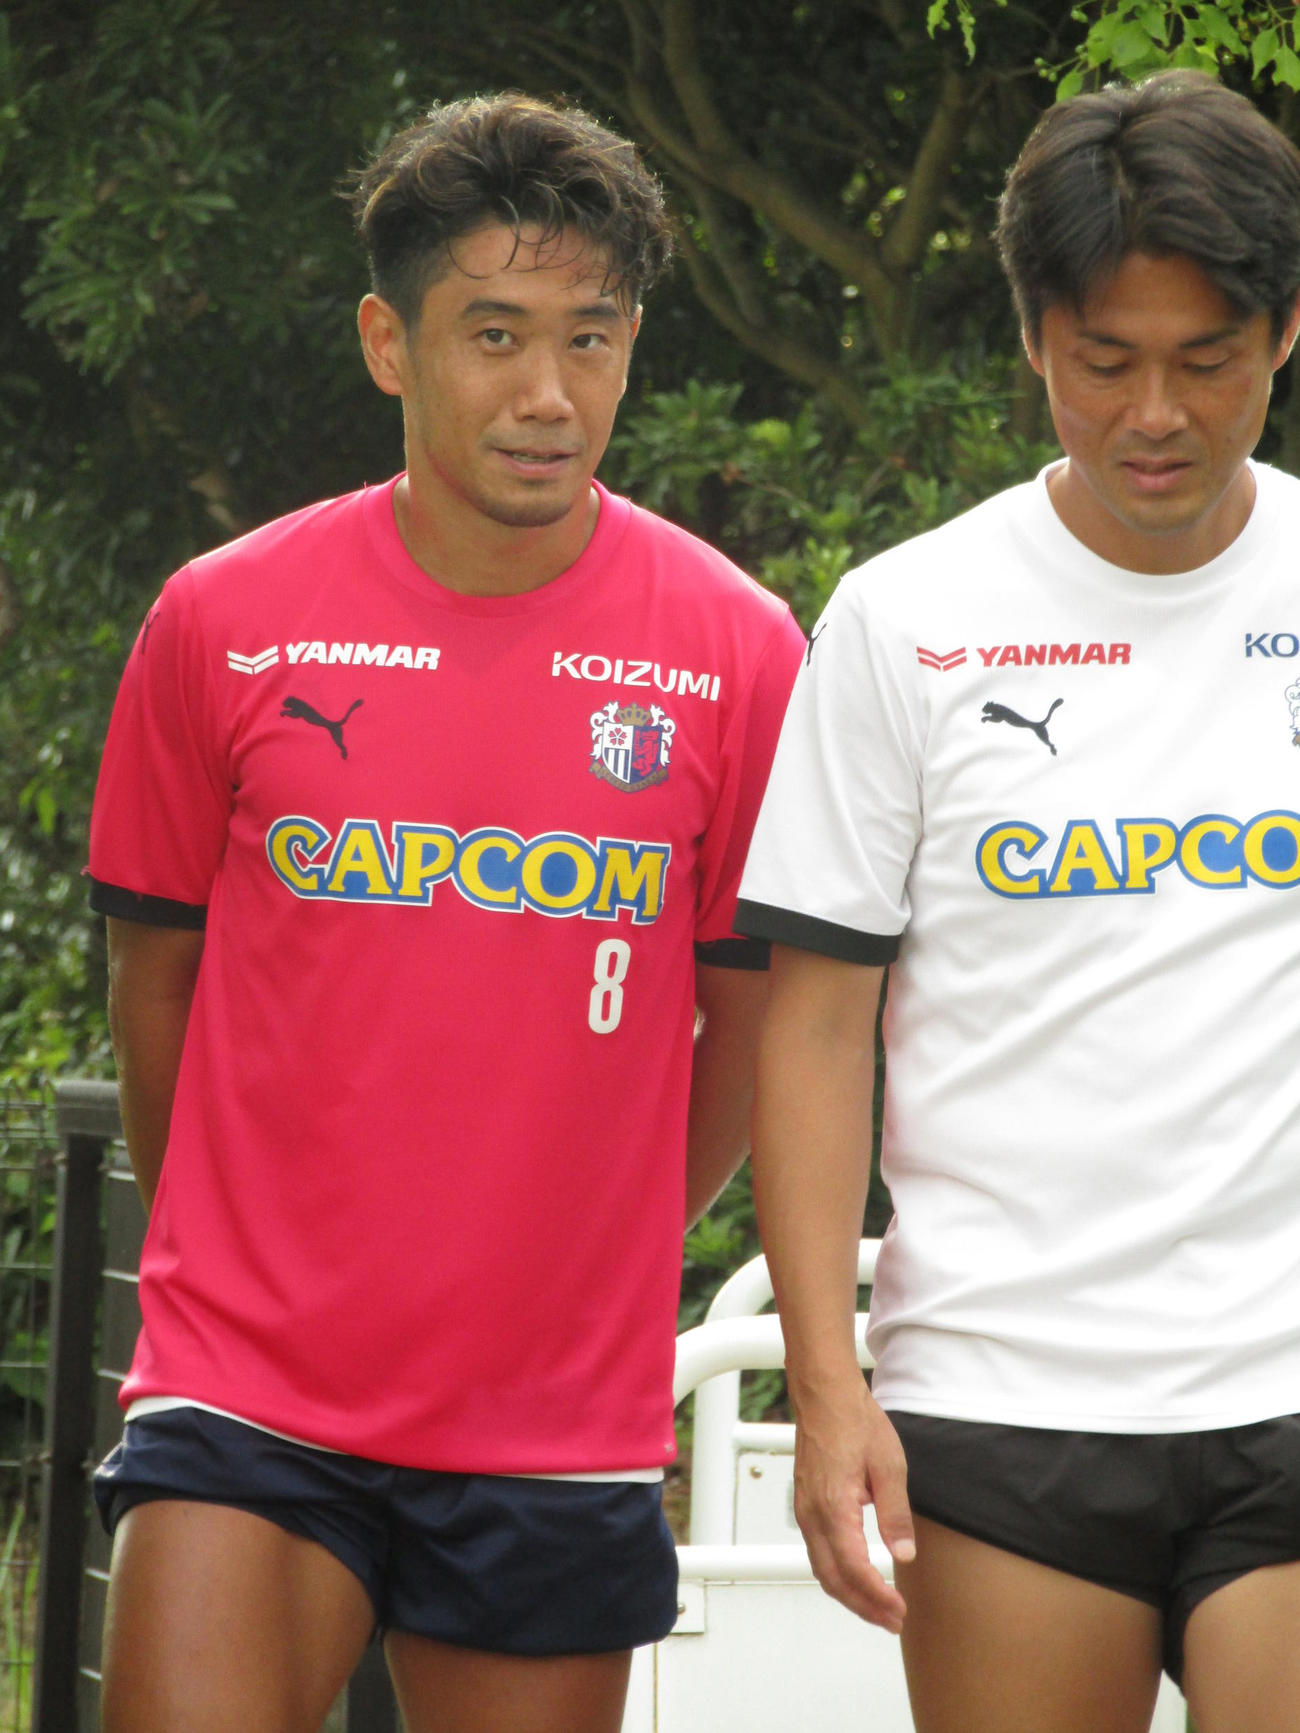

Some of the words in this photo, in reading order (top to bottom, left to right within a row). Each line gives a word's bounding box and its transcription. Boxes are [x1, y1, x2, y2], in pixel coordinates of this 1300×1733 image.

[285, 641, 441, 671] YANMAR
[552, 651, 721, 702] KOIZUMI
[976, 643, 1132, 667] YANMAR
[266, 815, 671, 926] CAPCOM
[975, 809, 1300, 900] CAPCO
[588, 938, 632, 1034] 8
